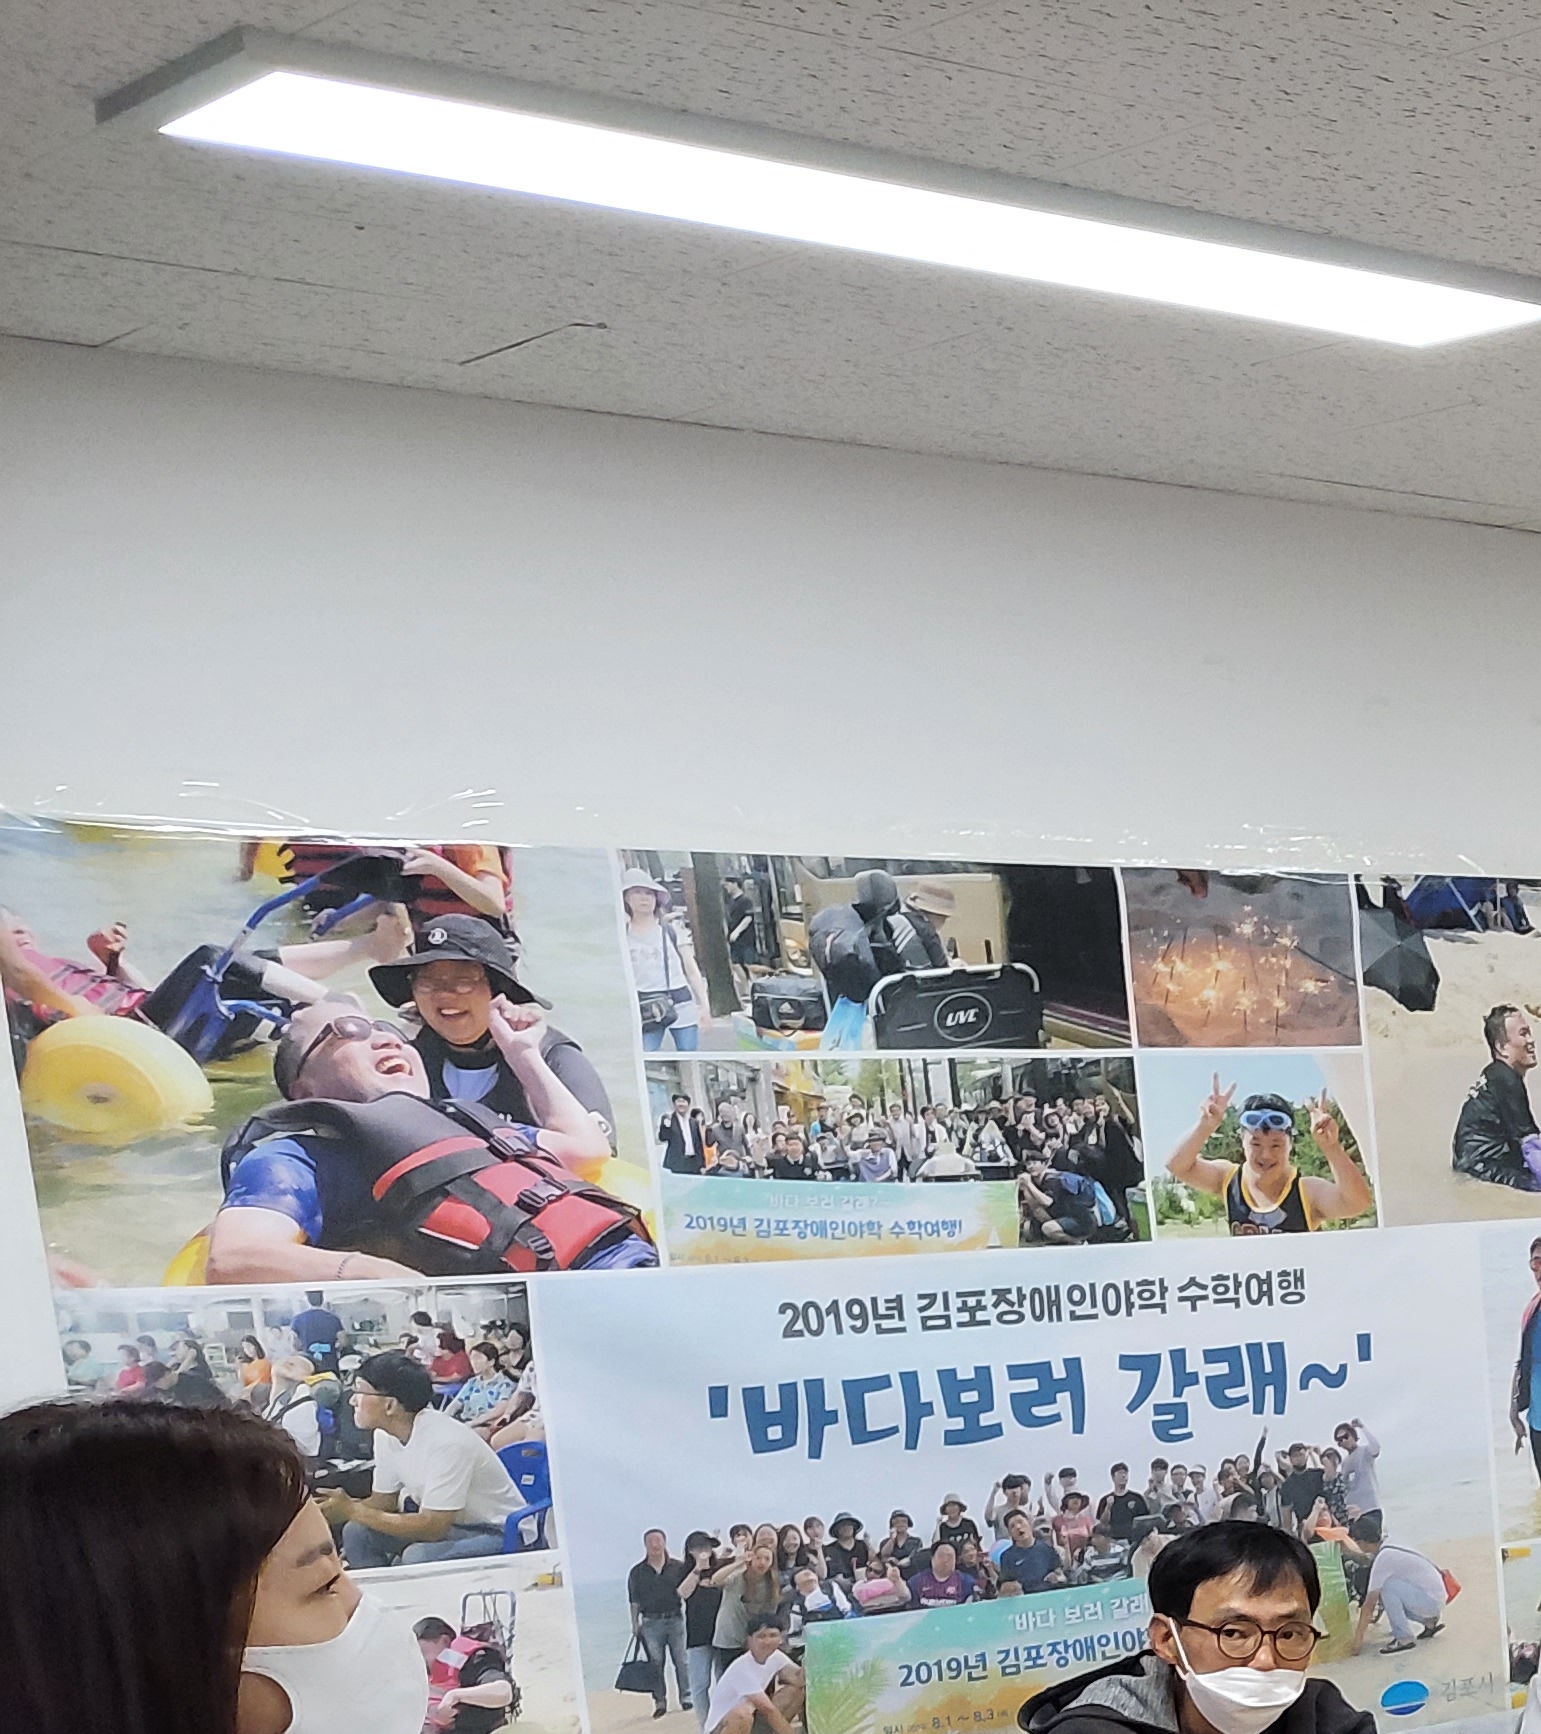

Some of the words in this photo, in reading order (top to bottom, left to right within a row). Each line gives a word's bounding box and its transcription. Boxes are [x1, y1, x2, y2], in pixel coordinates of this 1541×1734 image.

[684, 1213, 747, 1237] 2019년
[754, 1217, 883, 1240] 김포장애인야학
[889, 1219, 962, 1239] 수학여행!
[778, 1293, 910, 1339] 2019년
[916, 1278, 1169, 1332] 김포장애인야학
[1176, 1268, 1308, 1313] 수학여행
[708, 1356, 1085, 1460] '바다보러
[1118, 1333, 1373, 1444] 갈래~'
[1065, 1601, 1104, 1625] 보러
[898, 1651, 988, 1688] 2019년
[997, 1627, 1144, 1678] 김포장애인야
[1440, 1671, 1495, 1702] 김포시
